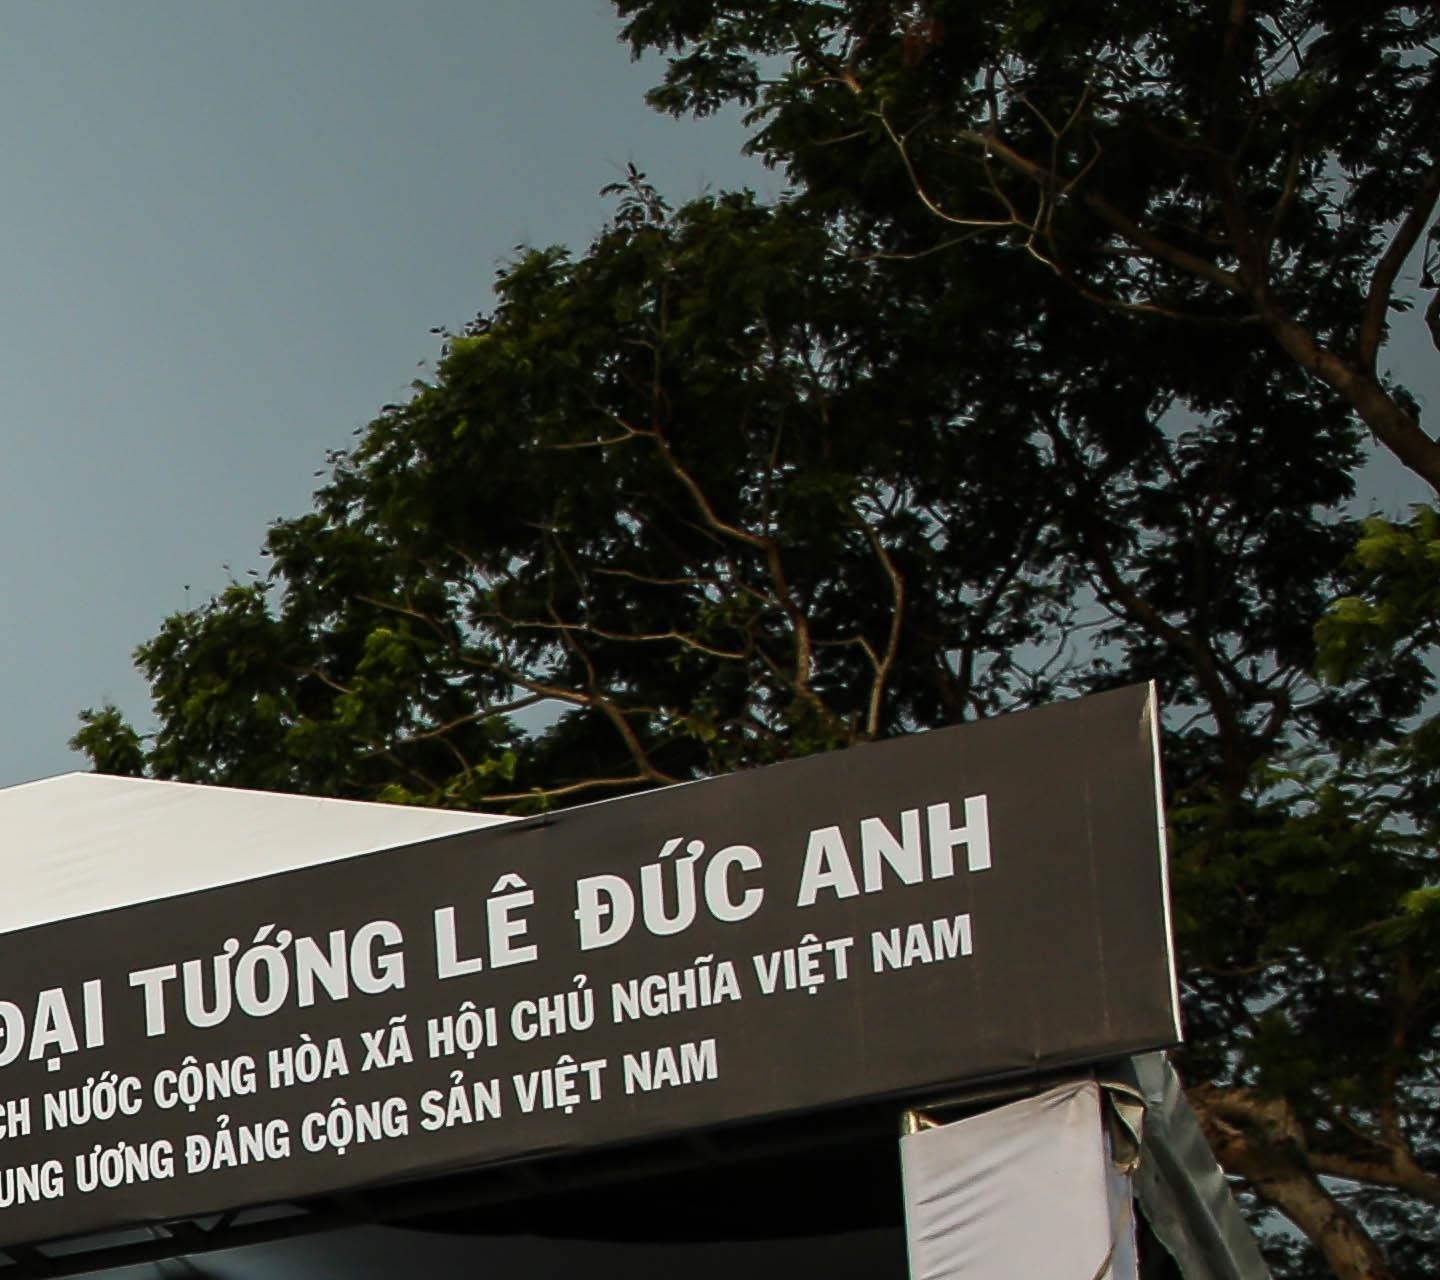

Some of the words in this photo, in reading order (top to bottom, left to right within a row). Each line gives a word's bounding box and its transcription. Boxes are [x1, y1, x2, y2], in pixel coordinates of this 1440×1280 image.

[43, 1068, 143, 1131] NƯỚC
[153, 1055, 257, 1113] CỘNG
[268, 1033, 350, 1089] HÒA
[360, 1014, 414, 1072] XÃ
[427, 1000, 498, 1060] HỘI
[510, 973, 595, 1042] CHỦ
[611, 953, 742, 1024] NGHĨA
[752, 933, 854, 995] VIỆT
[871, 913, 973, 973] NAM
[128, 920, 406, 1037] TƯỚNG
[434, 872, 538, 980] LÊ
[573, 837, 765, 951] ĐỨC
[796, 794, 992, 907] ANH
[75, 1139, 175, 1193] ƯƠNG
[184, 1114, 291, 1174] ĐẢNG
[301, 1096, 409, 1156] CỘNG
[420, 1069, 502, 1131] SẢN
[512, 1054, 608, 1115] VIỆT
[622, 1038, 719, 1095] NAM
